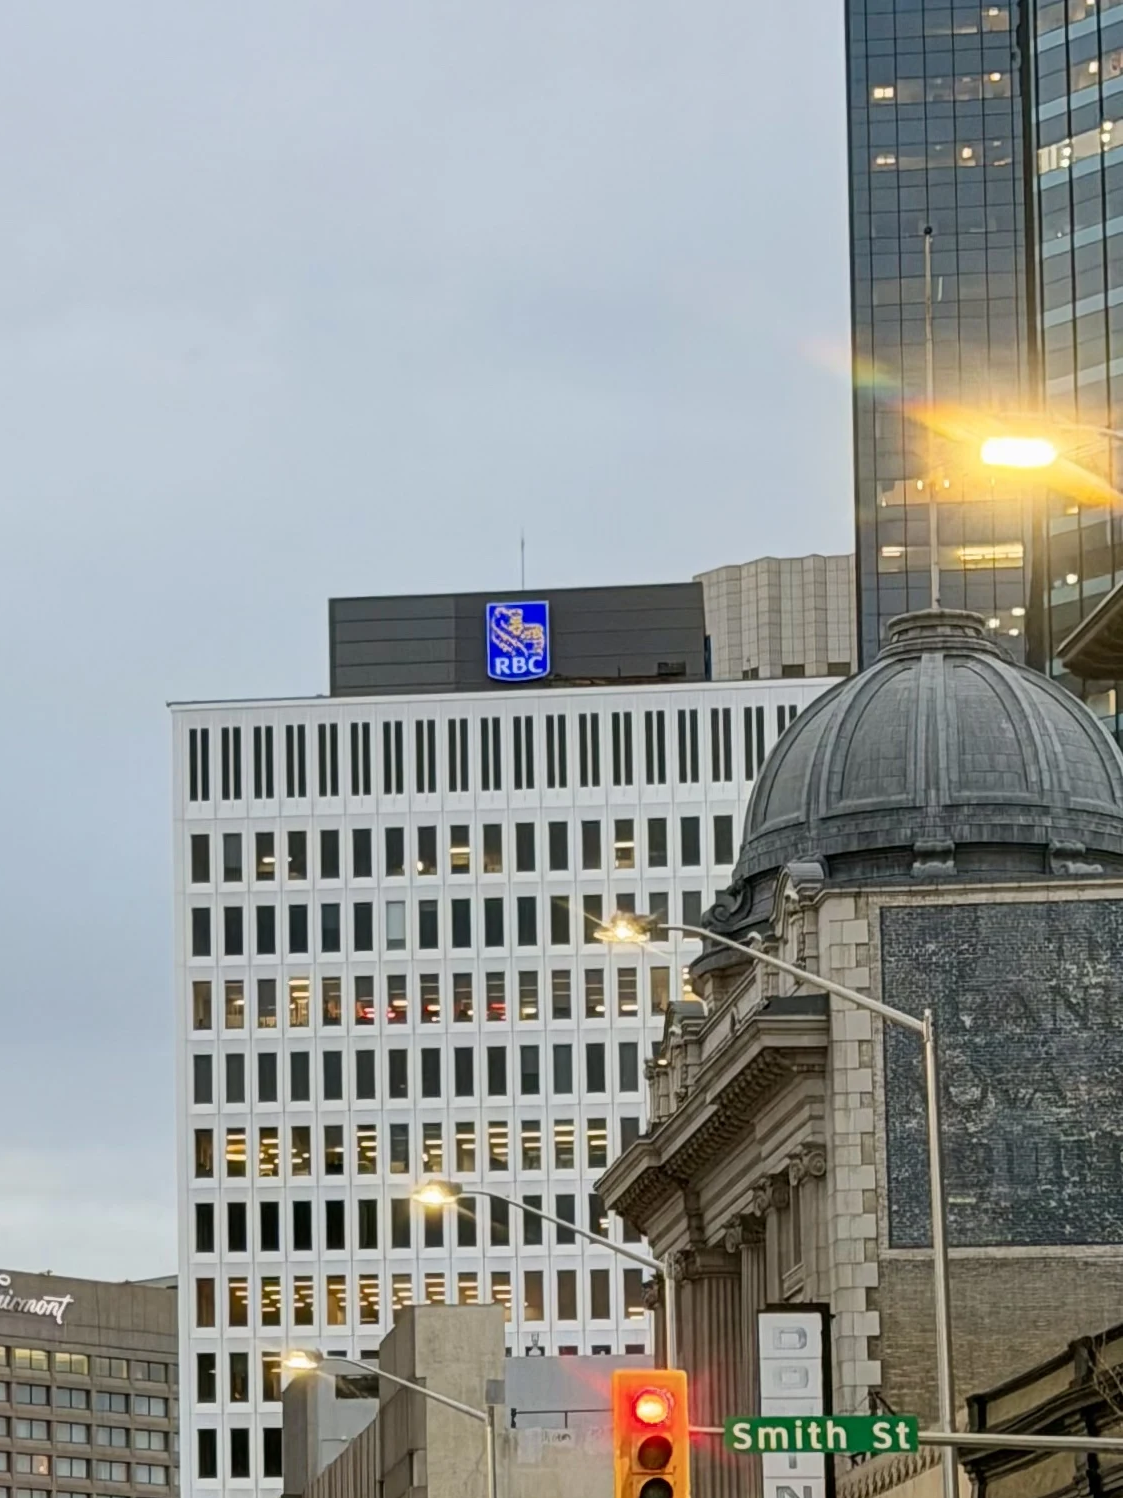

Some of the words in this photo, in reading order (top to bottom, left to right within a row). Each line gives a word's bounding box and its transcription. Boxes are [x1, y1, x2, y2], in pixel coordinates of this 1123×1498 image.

[494, 655, 544, 675] RBC
[732, 1419, 847, 1450] Smith
[872, 1421, 911, 1450] St
